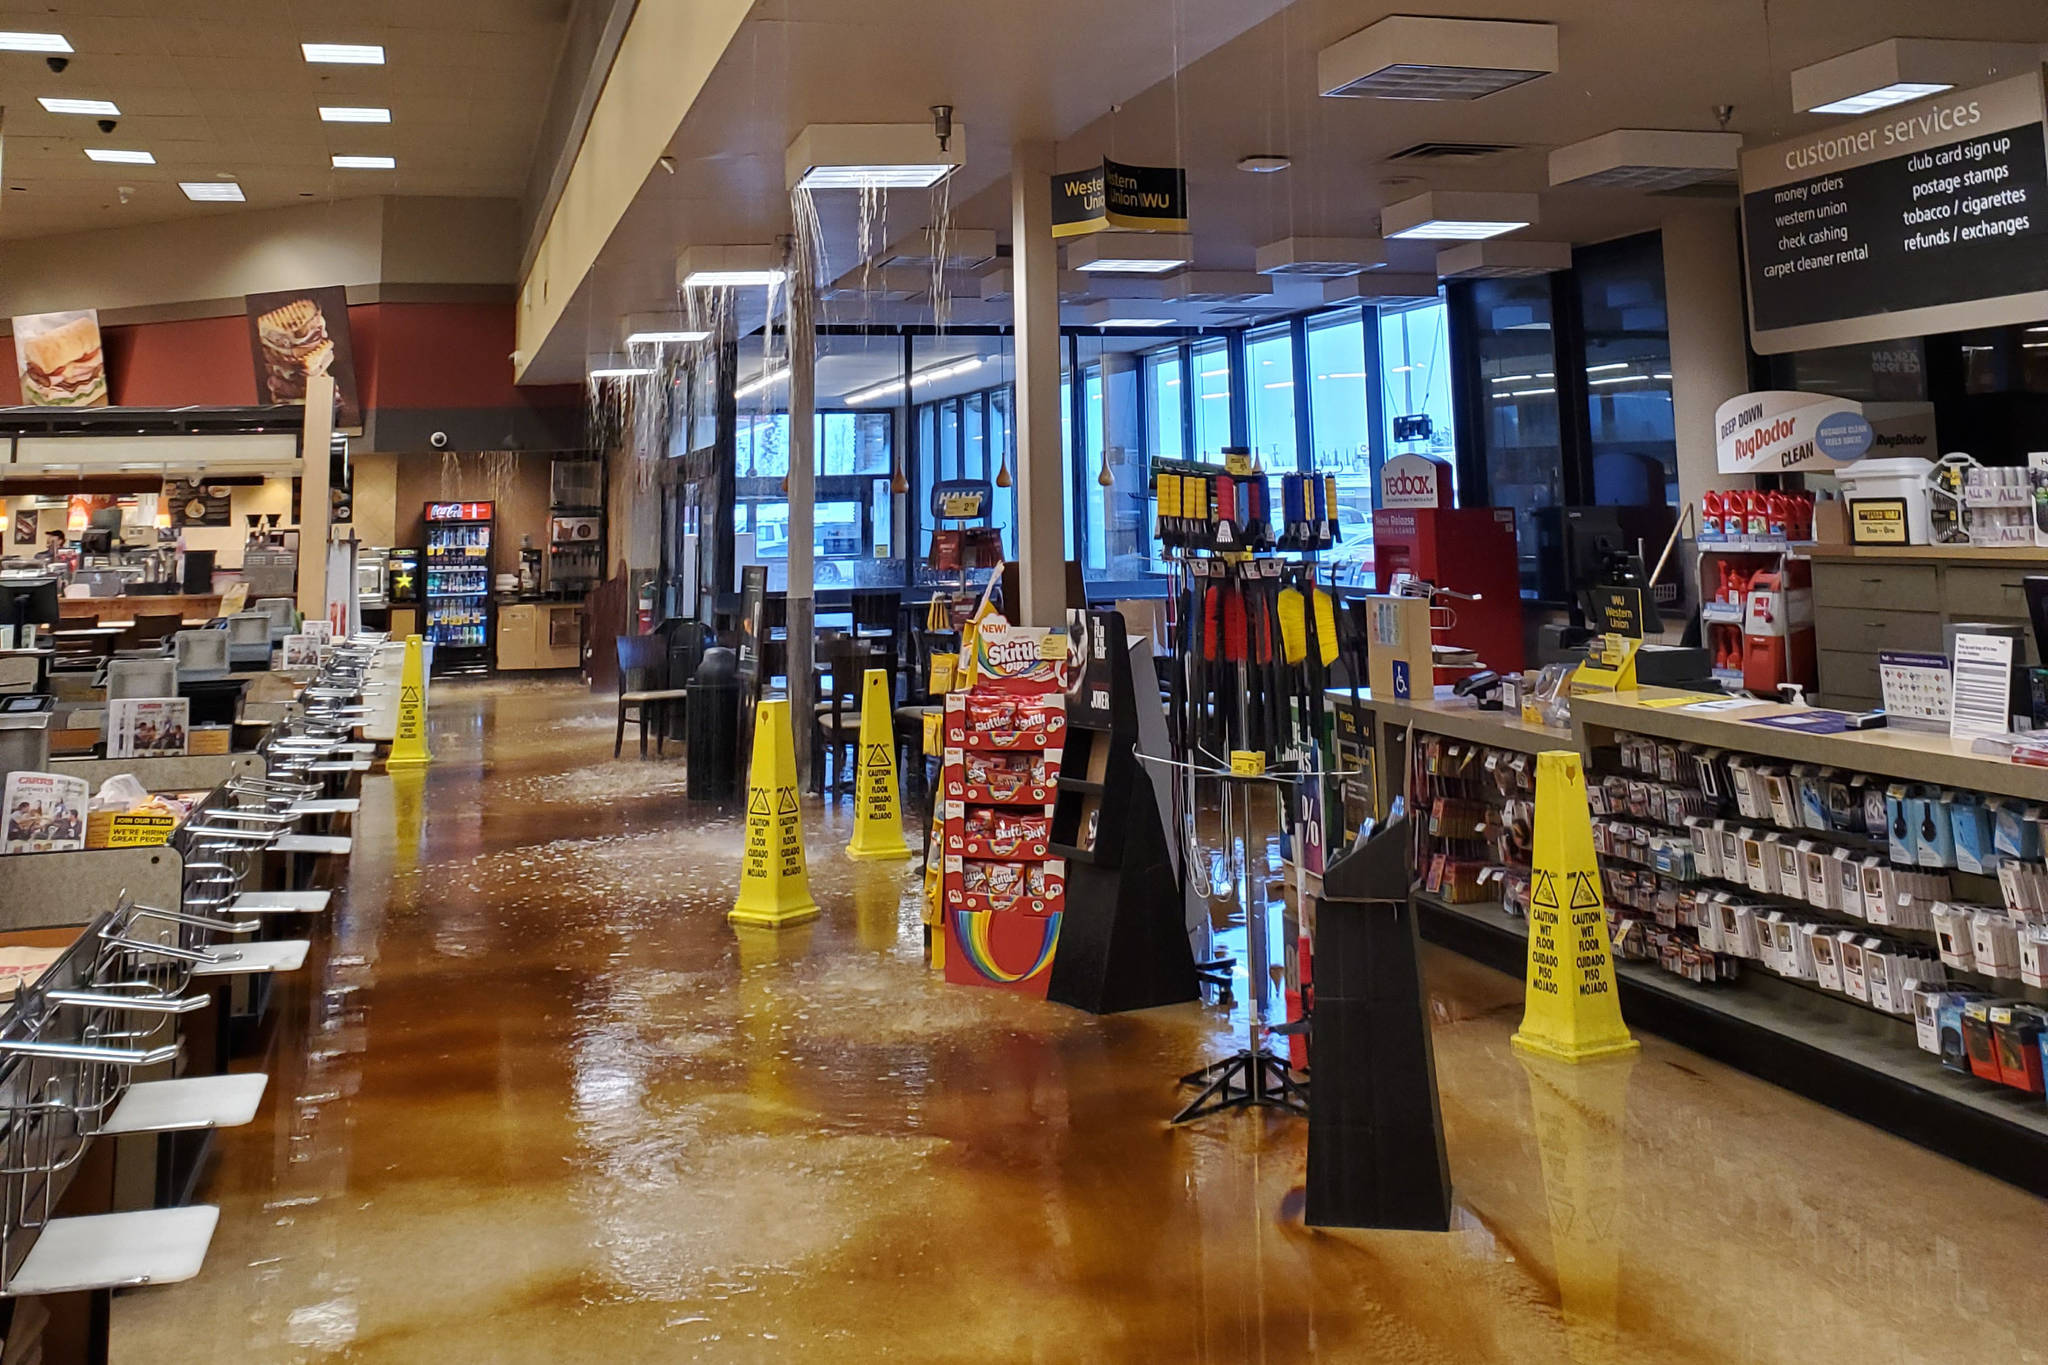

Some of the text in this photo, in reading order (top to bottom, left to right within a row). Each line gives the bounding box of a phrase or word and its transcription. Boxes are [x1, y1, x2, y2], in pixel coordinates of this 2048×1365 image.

[1785, 101, 1981, 170] customer services
[1908, 137, 2011, 173] club card sign up
[1912, 163, 2009, 201] postage stamps
[1775, 176, 1844, 205] money orders
[1084, 194, 1104, 211] Unio
[1903, 188, 2026, 226] tobacco / cigarettes
[1776, 201, 1847, 228] western union
[1778, 224, 1848, 251] check cashing
[1904, 214, 2030, 251] refunds / exchanges
[1764, 243, 1868, 279] carpet cleaner rental
[1721, 402, 1763, 440] DEEP DOWN
[1735, 417, 1796, 461] RugDoctor
[1781, 441, 1814, 468] CLEAN
[982, 624, 1006, 633] NEW!
[1610, 617, 1630, 629] Union
[988, 641, 1041, 667] Skittle
[1019, 713, 1045, 732] Skittl
[867, 769, 891, 778] CAUTION
[874, 777, 885, 785] WET
[868, 795, 892, 804] CUIDADO
[750, 817, 770, 827] CAUTION
[779, 816, 798, 827] CAUTION
[869, 811, 892, 820] MOJADO
[751, 837, 766, 847] FLOOR
[782, 835, 797, 845] FLOOR
[1533, 909, 1559, 925] CAUTION
[1571, 911, 1601, 926] CAUTION
[1540, 924, 1552, 937] WET
[1580, 924, 1595, 938] WET
[1536, 937, 1554, 951] FLOOR
[1578, 939, 1600, 952] FLOOR
[1532, 952, 1558, 968] CUIDADO
[1576, 954, 1606, 969] CUIDADO
[1538, 966, 1552, 980] PISO
[1584, 968, 1600, 982] PISO
[1533, 978, 1558, 995] MOJADO
[1579, 980, 1608, 996] MOJADO
